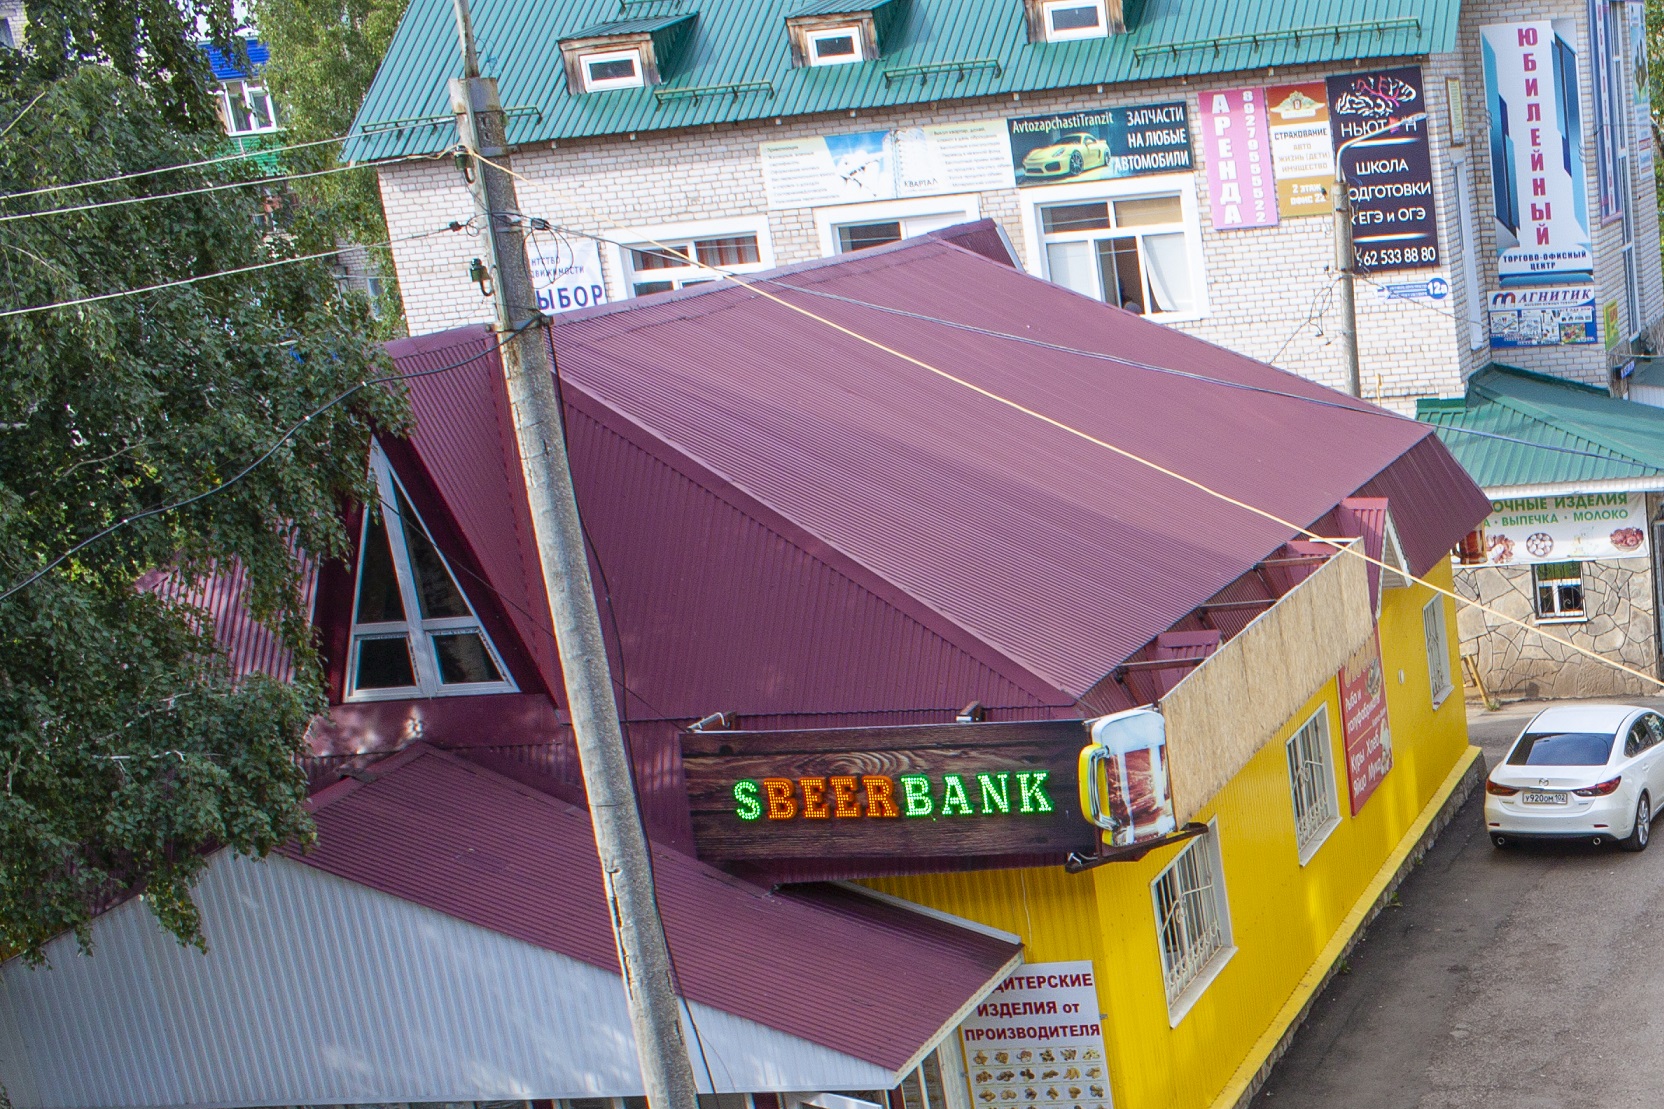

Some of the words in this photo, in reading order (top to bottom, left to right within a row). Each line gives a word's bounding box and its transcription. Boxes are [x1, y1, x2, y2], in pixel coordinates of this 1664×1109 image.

[1012, 112, 1114, 134] AvtozapchastiTranzit
[1127, 106, 1184, 127] ЗАПЧАСТИ
[1127, 132, 1144, 149] НА
[1145, 128, 1187, 147] ЛЮБЫЕ
[1274, 128, 1328, 140] СТРАХОВАНИЕ
[1517, 27, 1552, 246] ЮБИЛЕЙНЫЙ
[1114, 151, 1190, 172] АВТОМОБИЛИ
[1212, 93, 1243, 225] АРЕНДА
[1282, 163, 1328, 173] ИМУЩЕСТВО
[1355, 159, 1409, 175] ШКОЛА
[1349, 181, 1431, 203] ОДГОТОВКИ
[1359, 209, 1383, 225] ЕГЭ
[1398, 207, 1426, 221] ОГЭ
[1364, 250, 1378, 266] 62
[1380, 249, 1401, 265] 533
[1404, 247, 1419, 263] 88
[1421, 246, 1436, 261] 80
[1503, 250, 1587, 263] ТОРГОВО-ОФИСНЫЙ
[1530, 262, 1556, 271] ЦЕНТР
[535, 284, 603, 310] ЫБОР
[1492, 497, 1548, 513] ОЧНЫЕ
[1554, 492, 1628, 510] ИЗДЕЛИЯ
[1502, 512, 1558, 527] ВЫПЕЧКА
[1573, 509, 1628, 522] МОЛОКО
[733, 769, 1056, 822] SBEERBANK
[992, 973, 1093, 993] ДИТЕРСКИЕ
[977, 1001, 1058, 1018] ИЗДЕЛИЯ
[1062, 1003, 1080, 1014] от
[964, 1023, 1101, 1042] ПРОИЗВОДИТЕЛЯ
